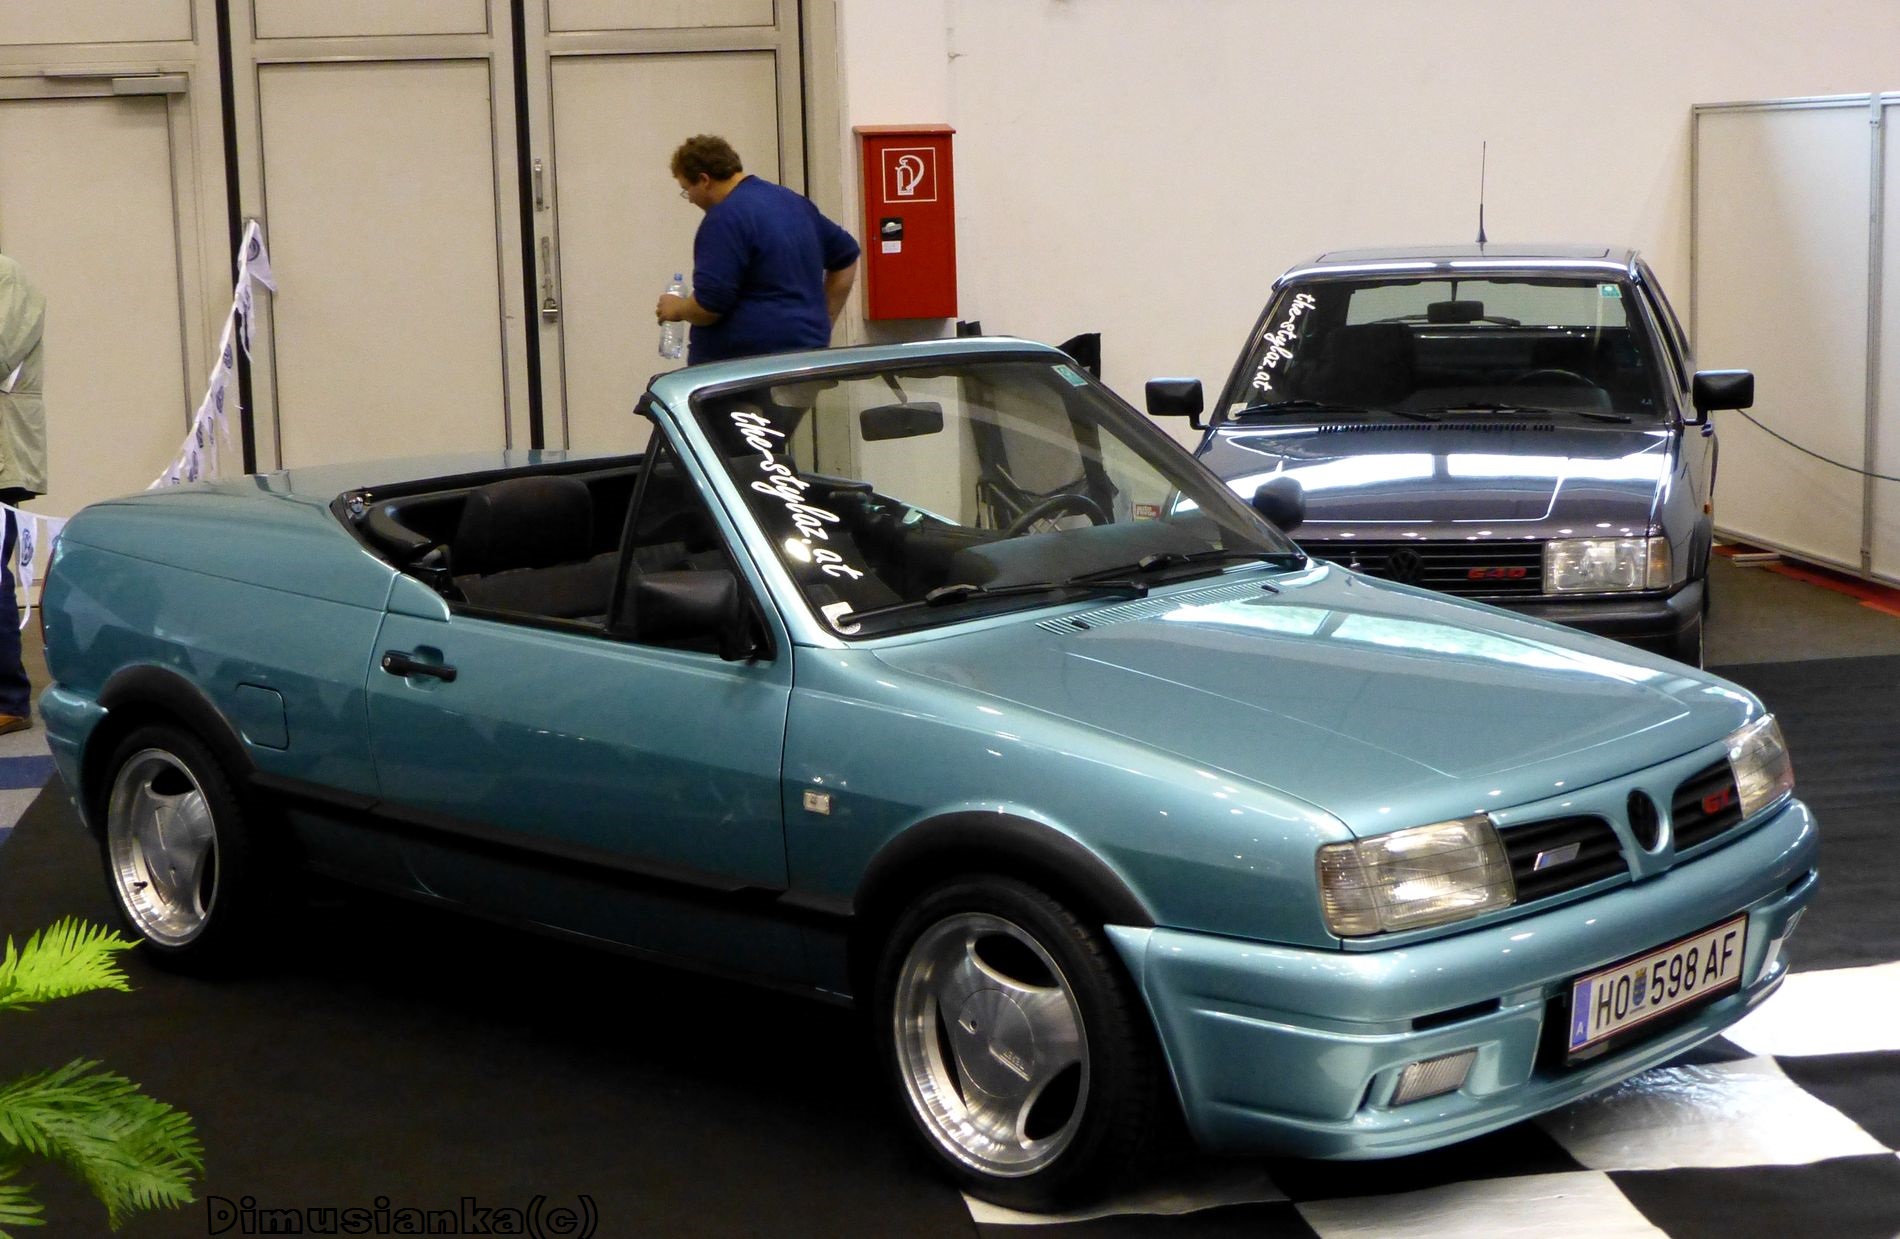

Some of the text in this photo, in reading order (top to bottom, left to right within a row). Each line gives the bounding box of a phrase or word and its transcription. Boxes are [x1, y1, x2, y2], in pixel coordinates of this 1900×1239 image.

[1253, 293, 1316, 391] the-stylaz.at
[730, 411, 864, 580] the-stylaz.at
[1467, 566, 1527, 581] G40
[1575, 1022, 1584, 1036] A
[1596, 931, 1736, 1029] HO 598 AF
